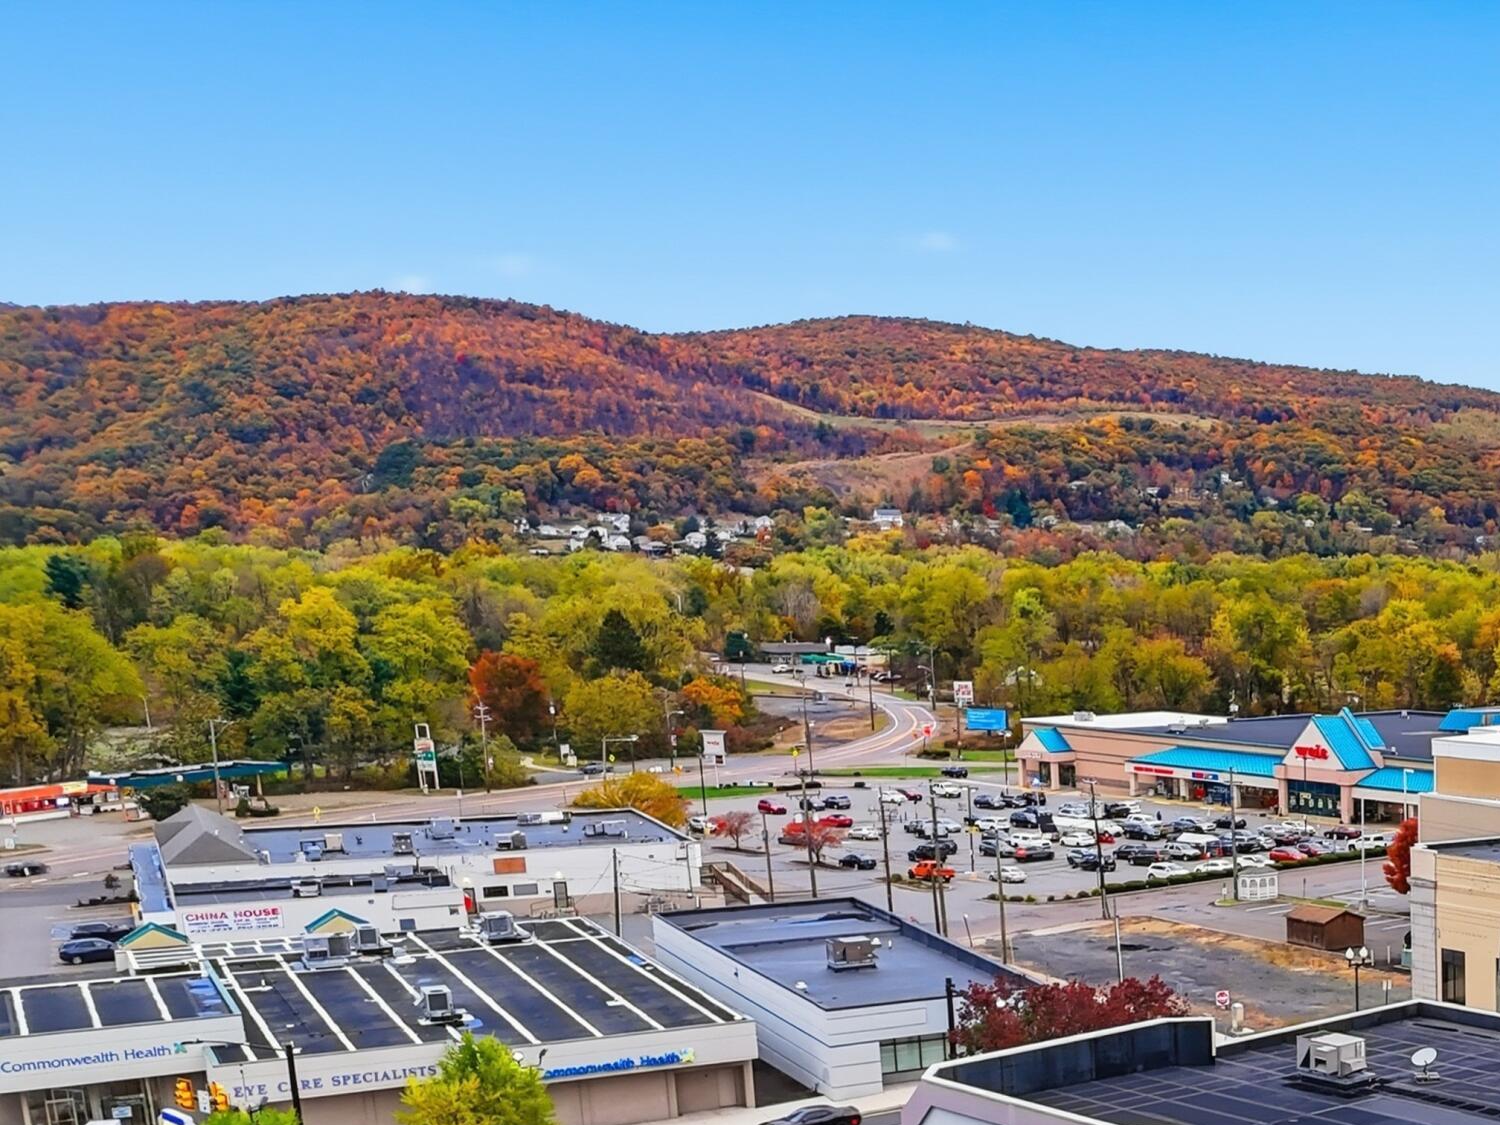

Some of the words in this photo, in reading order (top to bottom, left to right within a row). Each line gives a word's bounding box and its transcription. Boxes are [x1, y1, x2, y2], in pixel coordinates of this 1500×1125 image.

[185, 912, 228, 922] CHINA
[233, 907, 280, 919] HOUSE
[0, 1051, 120, 1073] Commonwealth
[124, 1045, 172, 1061] Health
[543, 1057, 635, 1080] ommonwealth
[234, 1084, 267, 1098] EYE
[278, 1078, 323, 1093] CRE
[331, 1065, 438, 1088] SPECIALISTS
